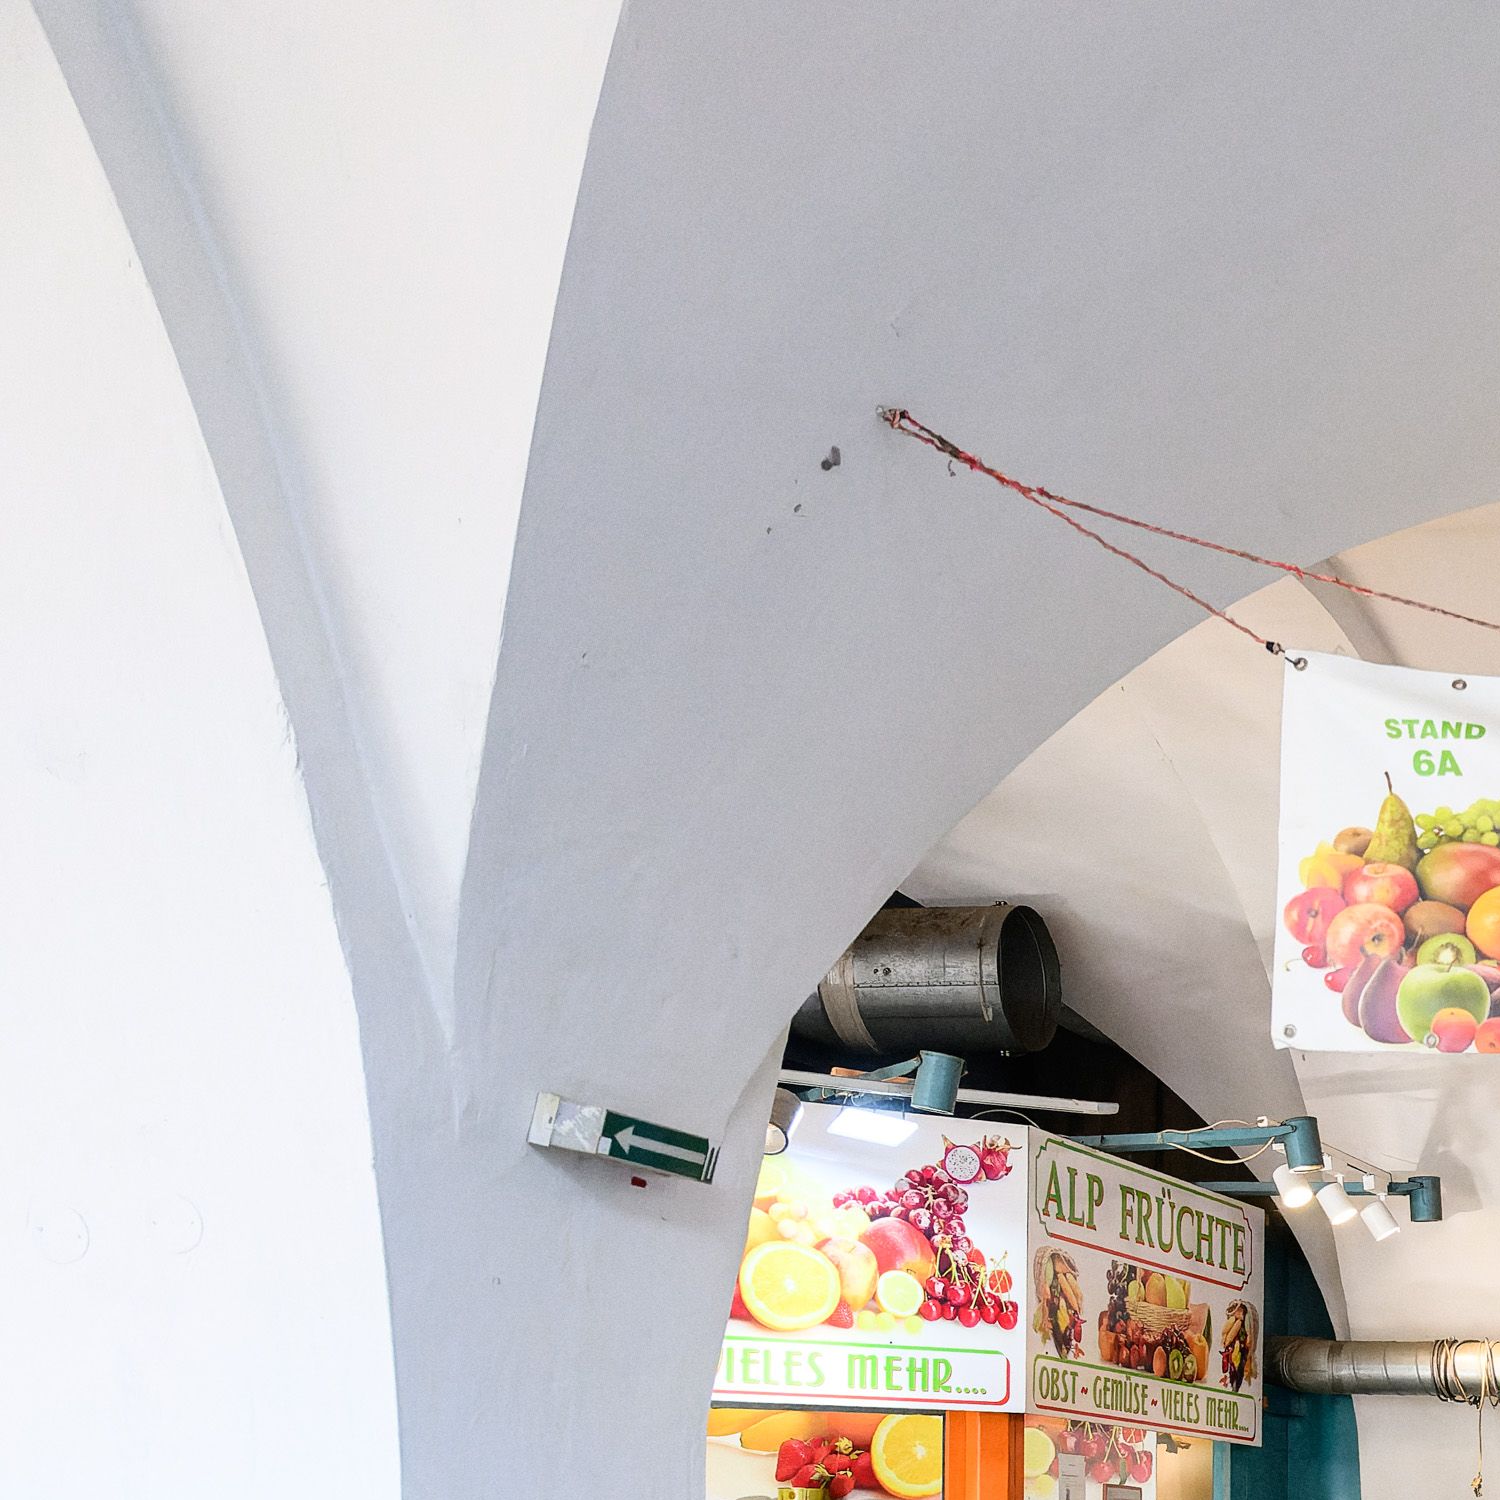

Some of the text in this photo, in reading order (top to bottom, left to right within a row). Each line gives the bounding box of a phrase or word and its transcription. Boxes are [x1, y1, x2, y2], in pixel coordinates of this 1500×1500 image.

[1385, 717, 1487, 742] STAND
[1411, 748, 1464, 779] 6A
[1042, 1159, 1247, 1277] ALP FRÜCHTE
[719, 1347, 826, 1387] IELES
[1038, 1366, 1079, 1405] OBST
[1093, 1374, 1149, 1417] GEMÜSE
[1161, 1387, 1200, 1425] VIELES
